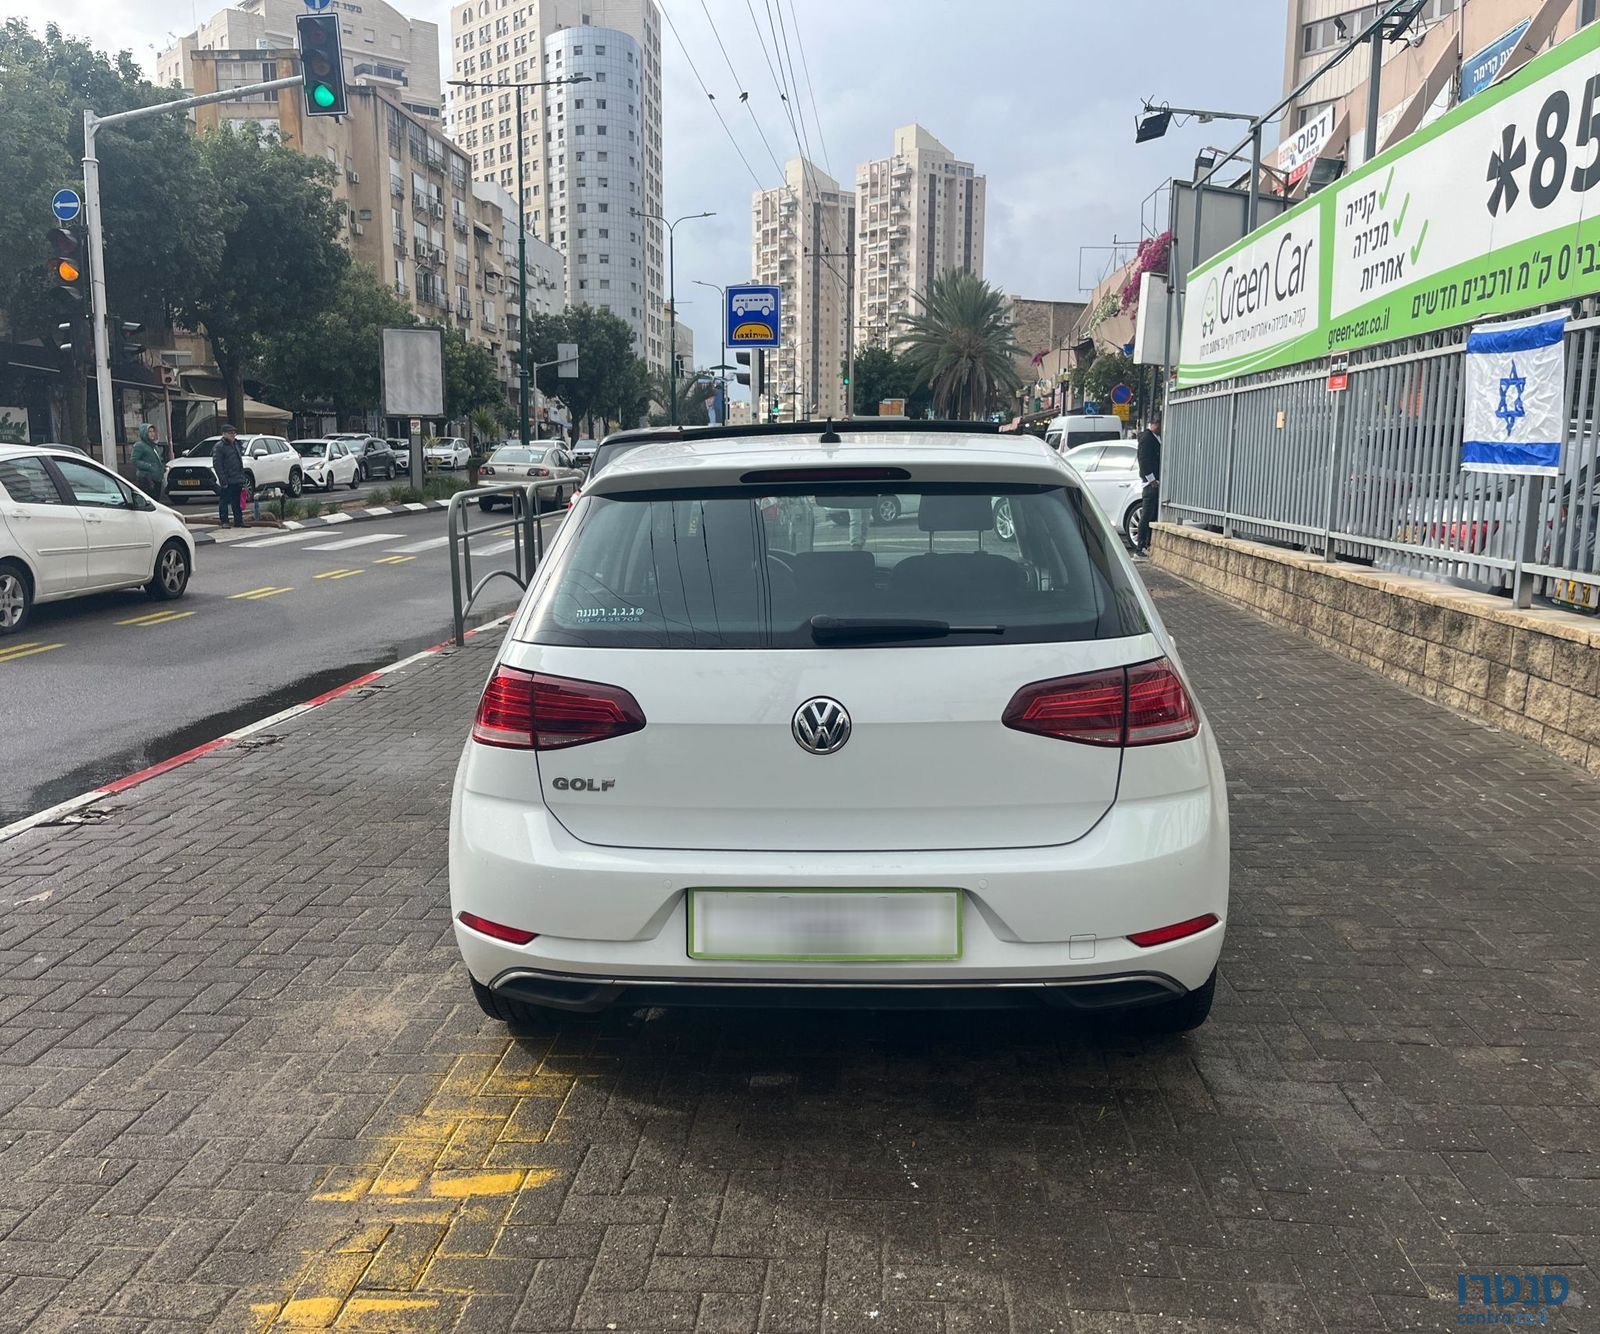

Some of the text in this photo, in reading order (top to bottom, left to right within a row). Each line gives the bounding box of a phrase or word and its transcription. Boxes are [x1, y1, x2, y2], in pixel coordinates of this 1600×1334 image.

[1473, 56, 1498, 83] קדימה
[1297, 116, 1327, 154] דפוס
[1345, 190, 1376, 228] קנייה
[1353, 221, 1389, 259] מכירה
[1220, 232, 1313, 325] Green Car
[1360, 252, 1405, 293] אחריות
[1460, 266, 1513, 305] ורכבים
[1411, 284, 1457, 319] חדשים
[1328, 307, 1391, 350] green-car.co.il
[576, 608, 606, 617] רעננה
[552, 777, 616, 792] GOLF
